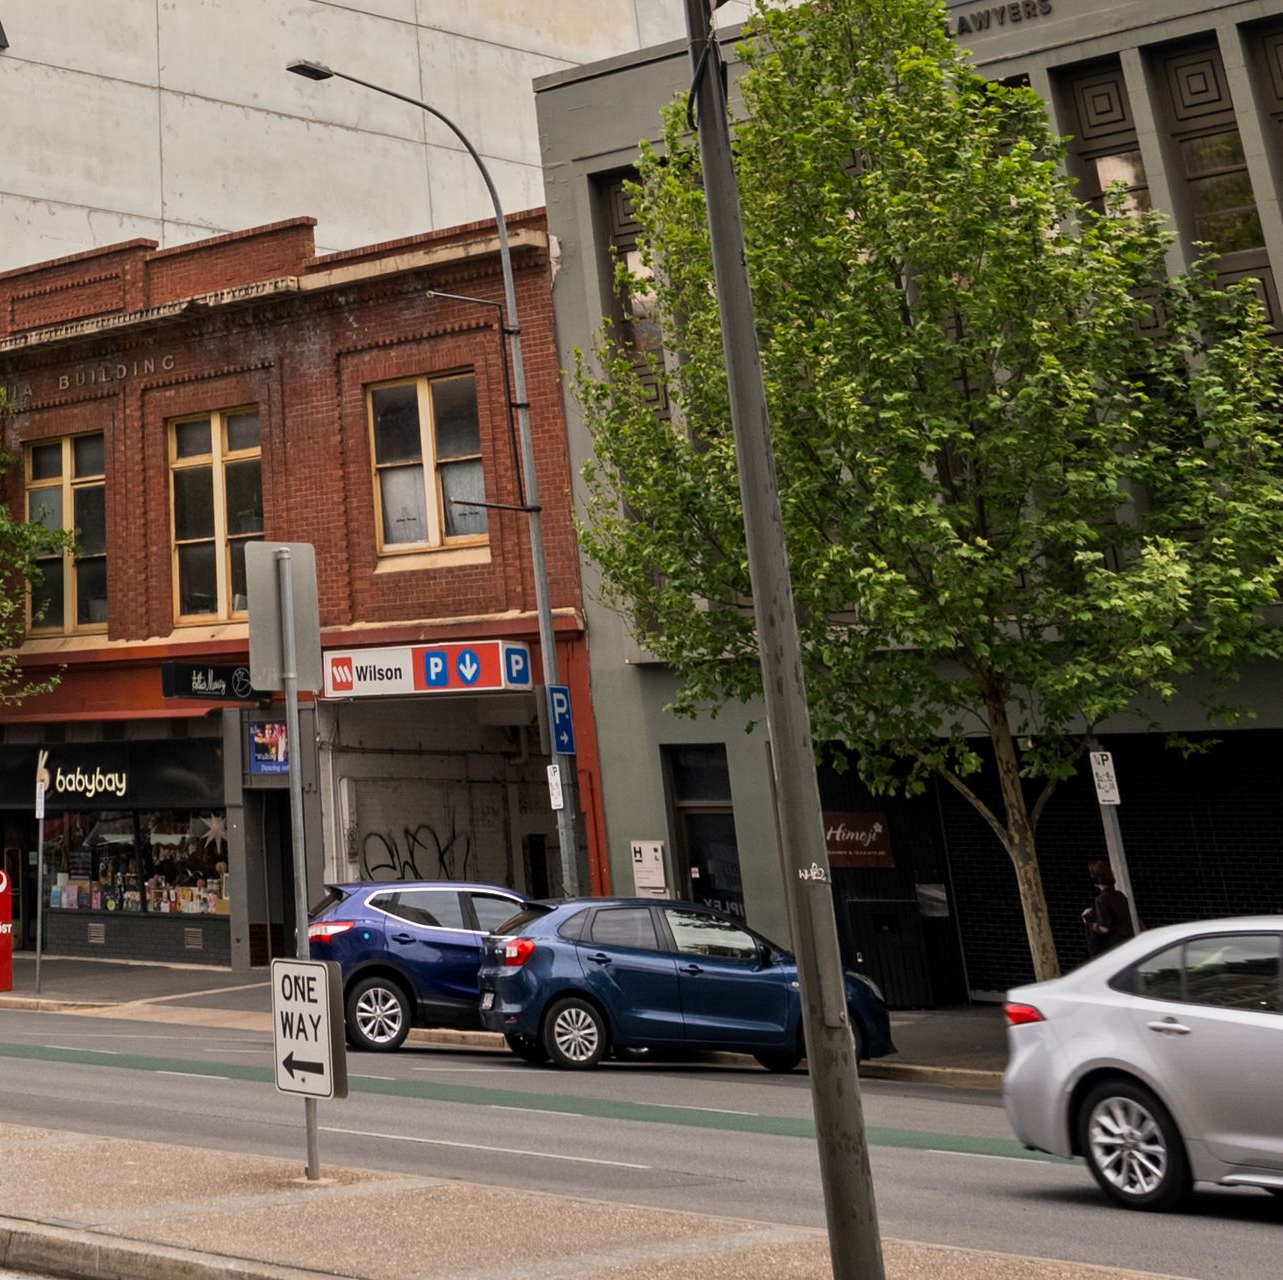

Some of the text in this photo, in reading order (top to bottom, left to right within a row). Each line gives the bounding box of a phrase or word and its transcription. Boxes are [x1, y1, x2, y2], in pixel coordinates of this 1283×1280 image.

[58, 354, 176, 391] BUILDING
[355, 656, 443, 682] Wilson P
[55, 766, 127, 798] babybay
[826, 822, 877, 847] Himoji
[281, 973, 318, 1003] ONE
[280, 1010, 321, 1042] WAY
